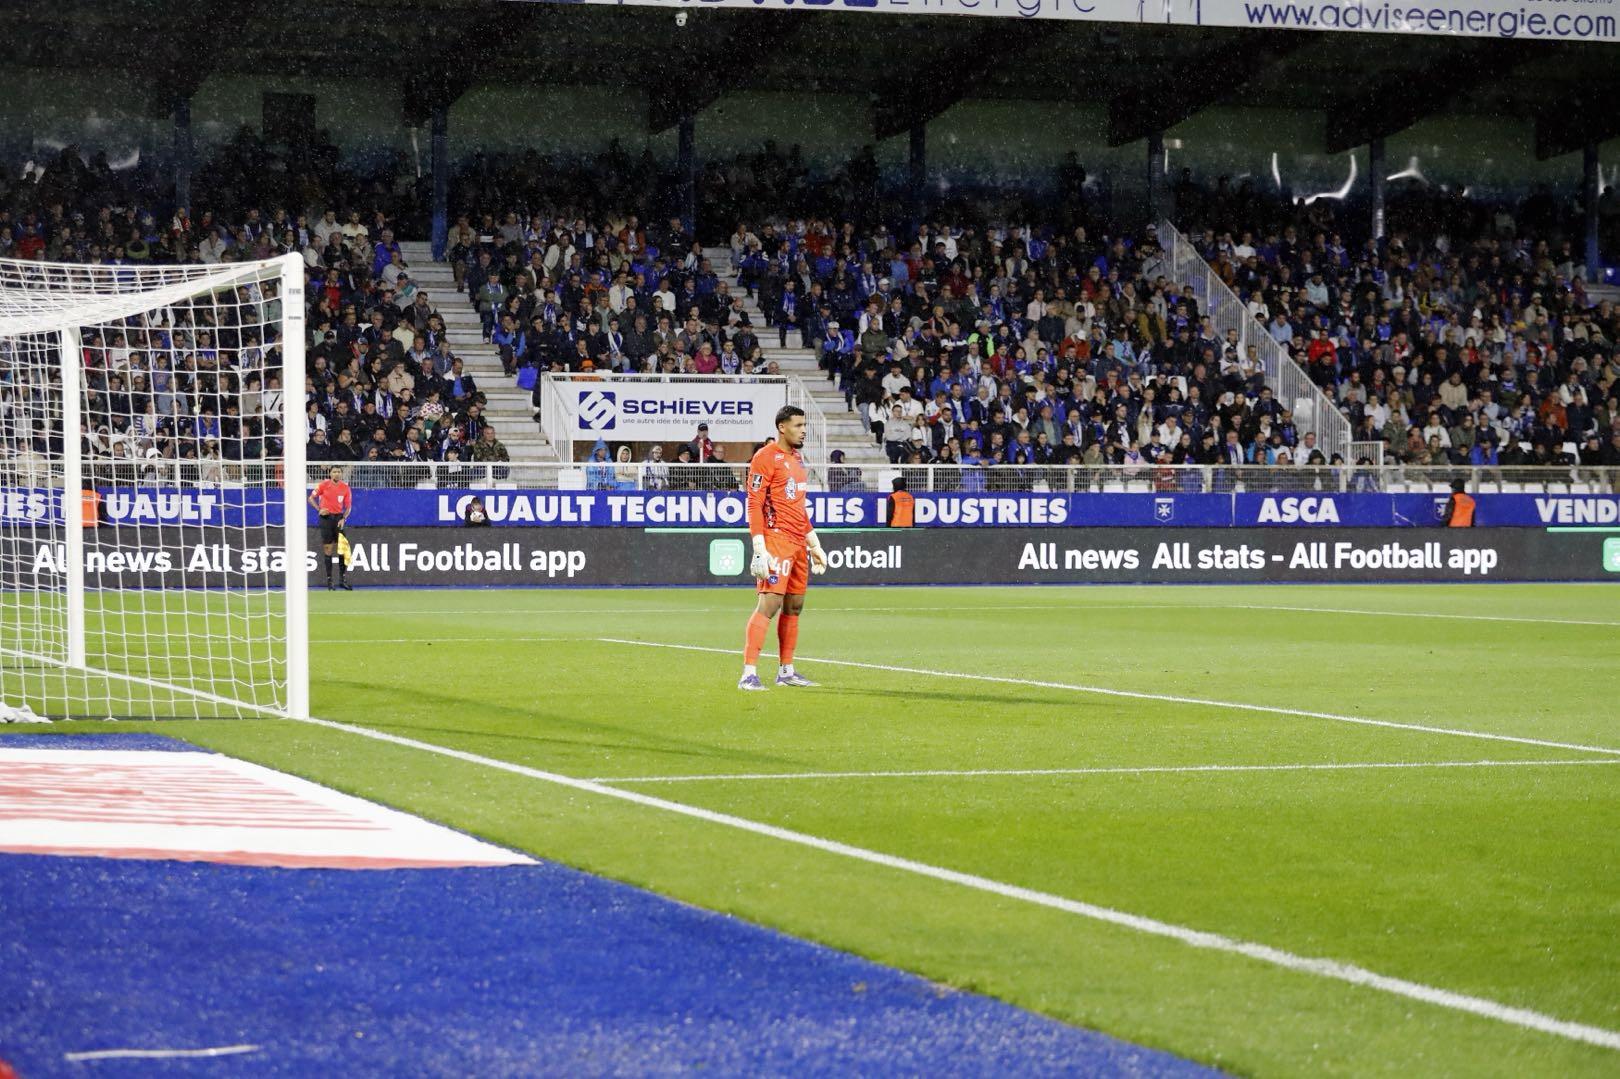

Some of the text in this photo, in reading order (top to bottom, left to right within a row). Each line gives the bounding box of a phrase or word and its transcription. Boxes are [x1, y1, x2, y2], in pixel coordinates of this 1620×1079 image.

[1244, 2, 1617, 39] www.adviseenergie.com
[608, 496, 864, 523] TECHNOIES
[877, 498, 1067, 523] IDUSTRIES
[1258, 498, 1340, 523] ASCA
[1535, 498, 1620, 523] VEND
[32, 544, 67, 573] Al
[86, 551, 172, 573] news
[188, 544, 232, 572] All
[241, 547, 318, 572] stas
[347, 543, 391, 572] All
[399, 543, 522, 572] Football
[530, 550, 586, 577] app
[1018, 543, 1058, 570] All
[1065, 549, 1139, 570] news
[1152, 543, 1192, 570] All
[1198, 545, 1265, 570] stats
[1289, 542, 1329, 569] All
[1335, 542, 1443, 569] Football
[1449, 548, 1498, 575] app
